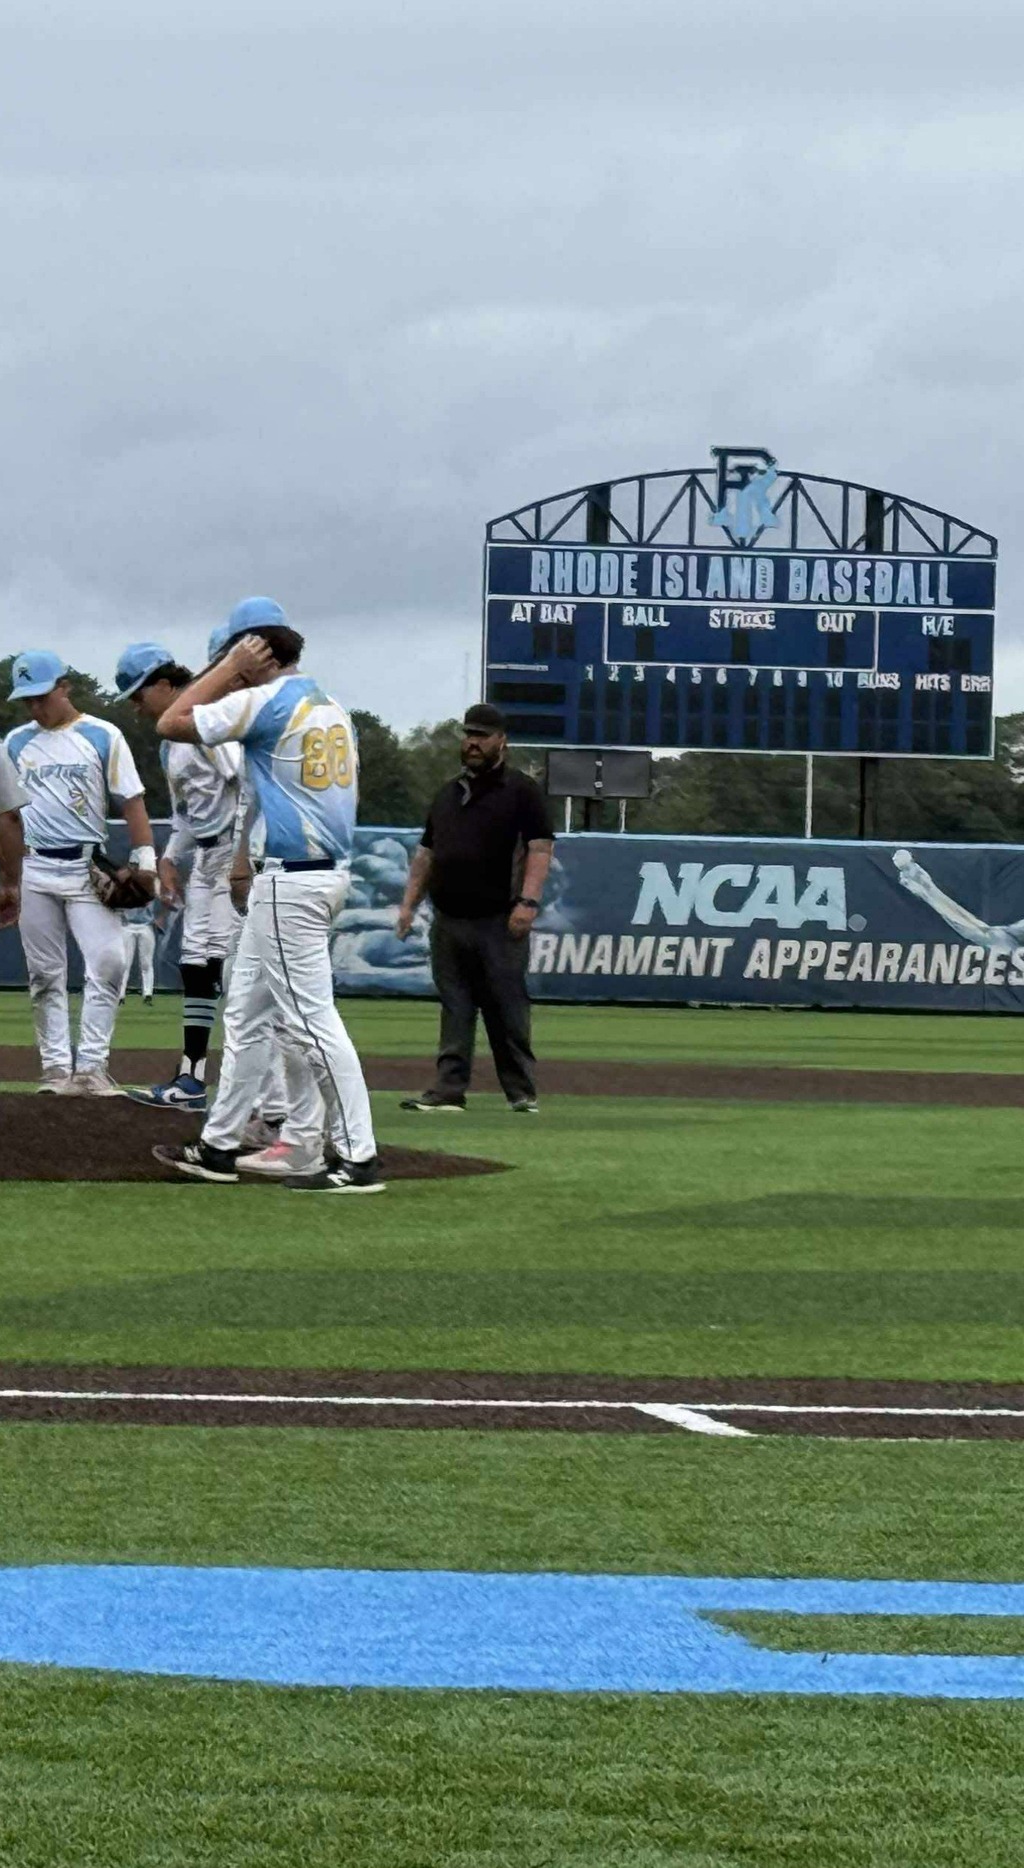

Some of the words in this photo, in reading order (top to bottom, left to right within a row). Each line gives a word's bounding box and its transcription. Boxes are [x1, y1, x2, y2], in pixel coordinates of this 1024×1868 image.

[530, 550, 639, 597] RHODE
[651, 553, 774, 600] ISLAND
[788, 558, 954, 606] BASEBALL
[511, 602, 535, 622] AT
[622, 606, 671, 627] BALL
[817, 612, 856, 633] OUT
[922, 615, 955, 637] H/E
[585, 664, 594, 682] 1
[608, 664, 620, 682] 2
[633, 664, 646, 682] 3
[666, 667, 676, 684] 4
[691, 667, 702, 685] 5
[716, 667, 727, 685] 6
[748, 668, 759, 687] 7
[773, 669, 783, 687] 8
[797, 670, 808, 688] 9
[826, 671, 844, 688] 10
[915, 673, 951, 692] HITS
[301, 724, 354, 792] 88
[631, 861, 848, 931] NCAA
[744, 937, 1024, 986] APPEARANCES
